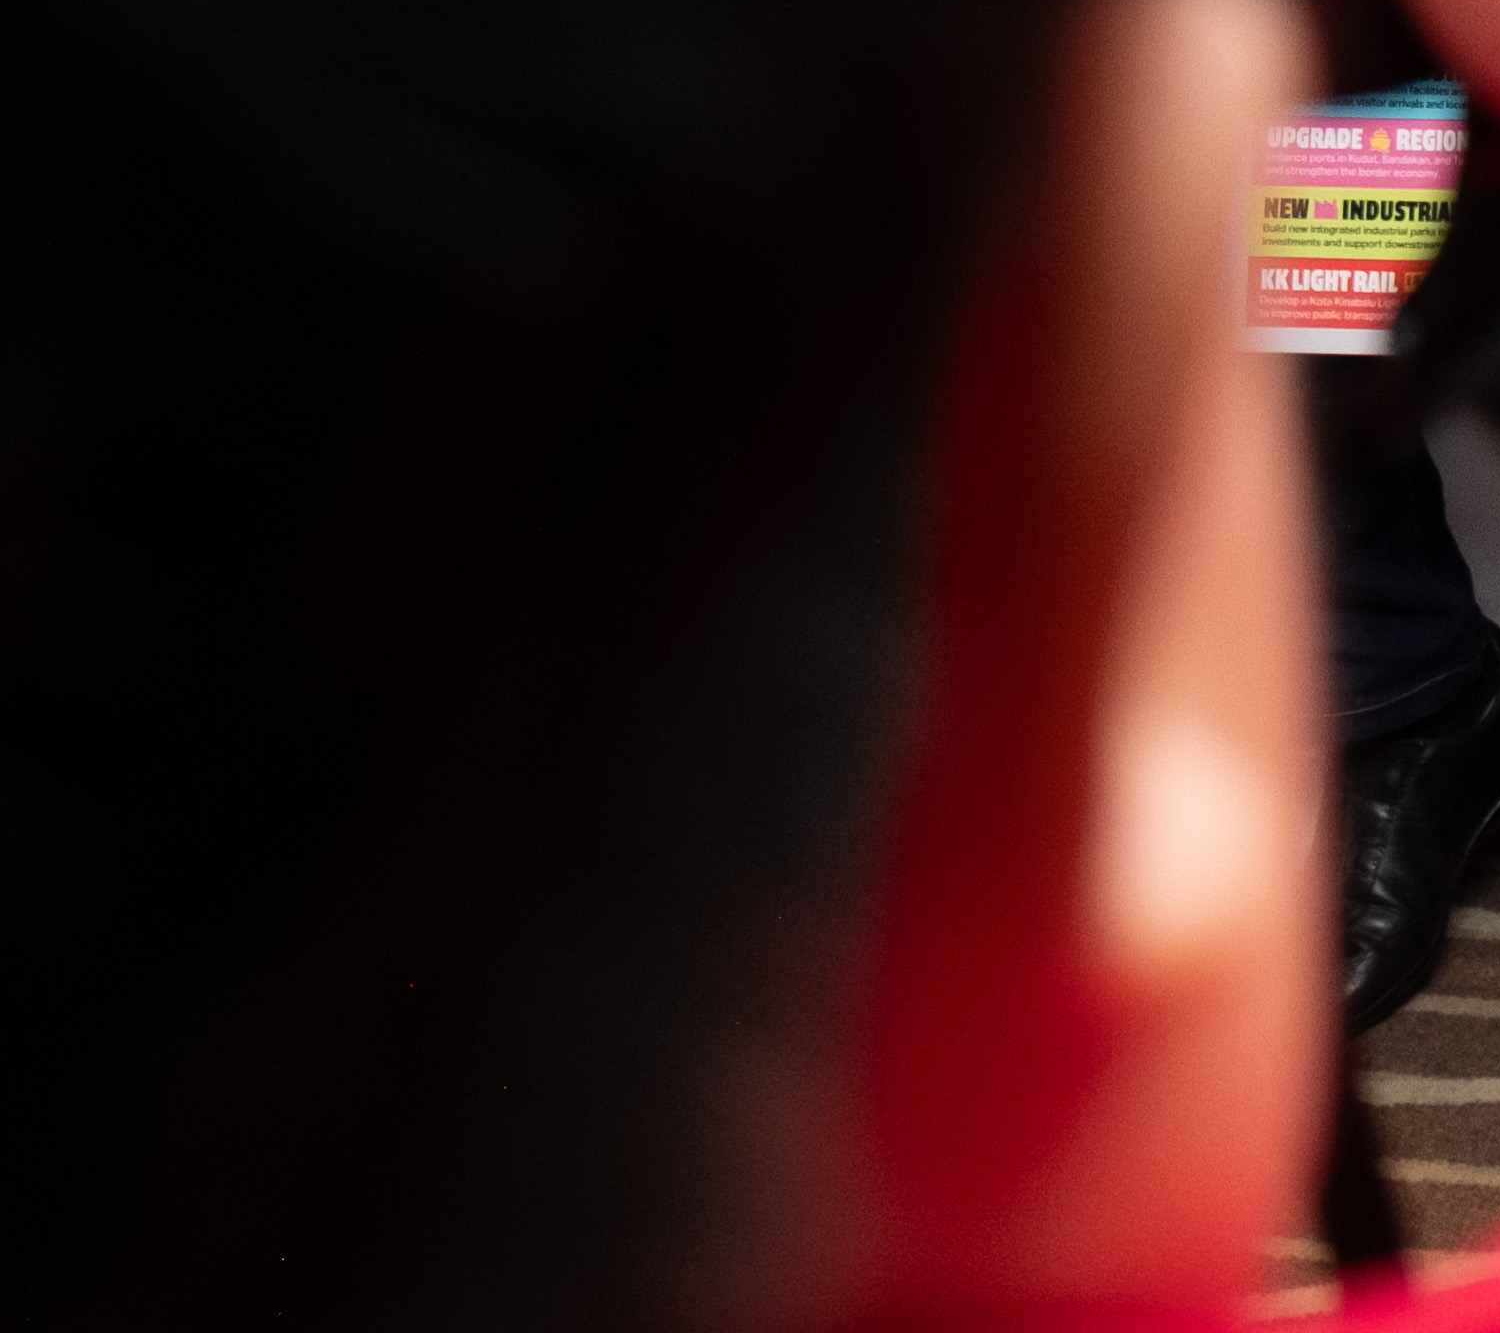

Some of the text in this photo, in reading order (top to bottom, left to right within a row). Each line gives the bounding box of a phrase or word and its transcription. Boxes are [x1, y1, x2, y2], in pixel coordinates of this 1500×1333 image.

[1267, 127, 1468, 151] UPGRADE REGION
[1265, 198, 1451, 222] NEW INDUSTRIA
[1260, 269, 1398, 294] KK LIGHT RAIL
